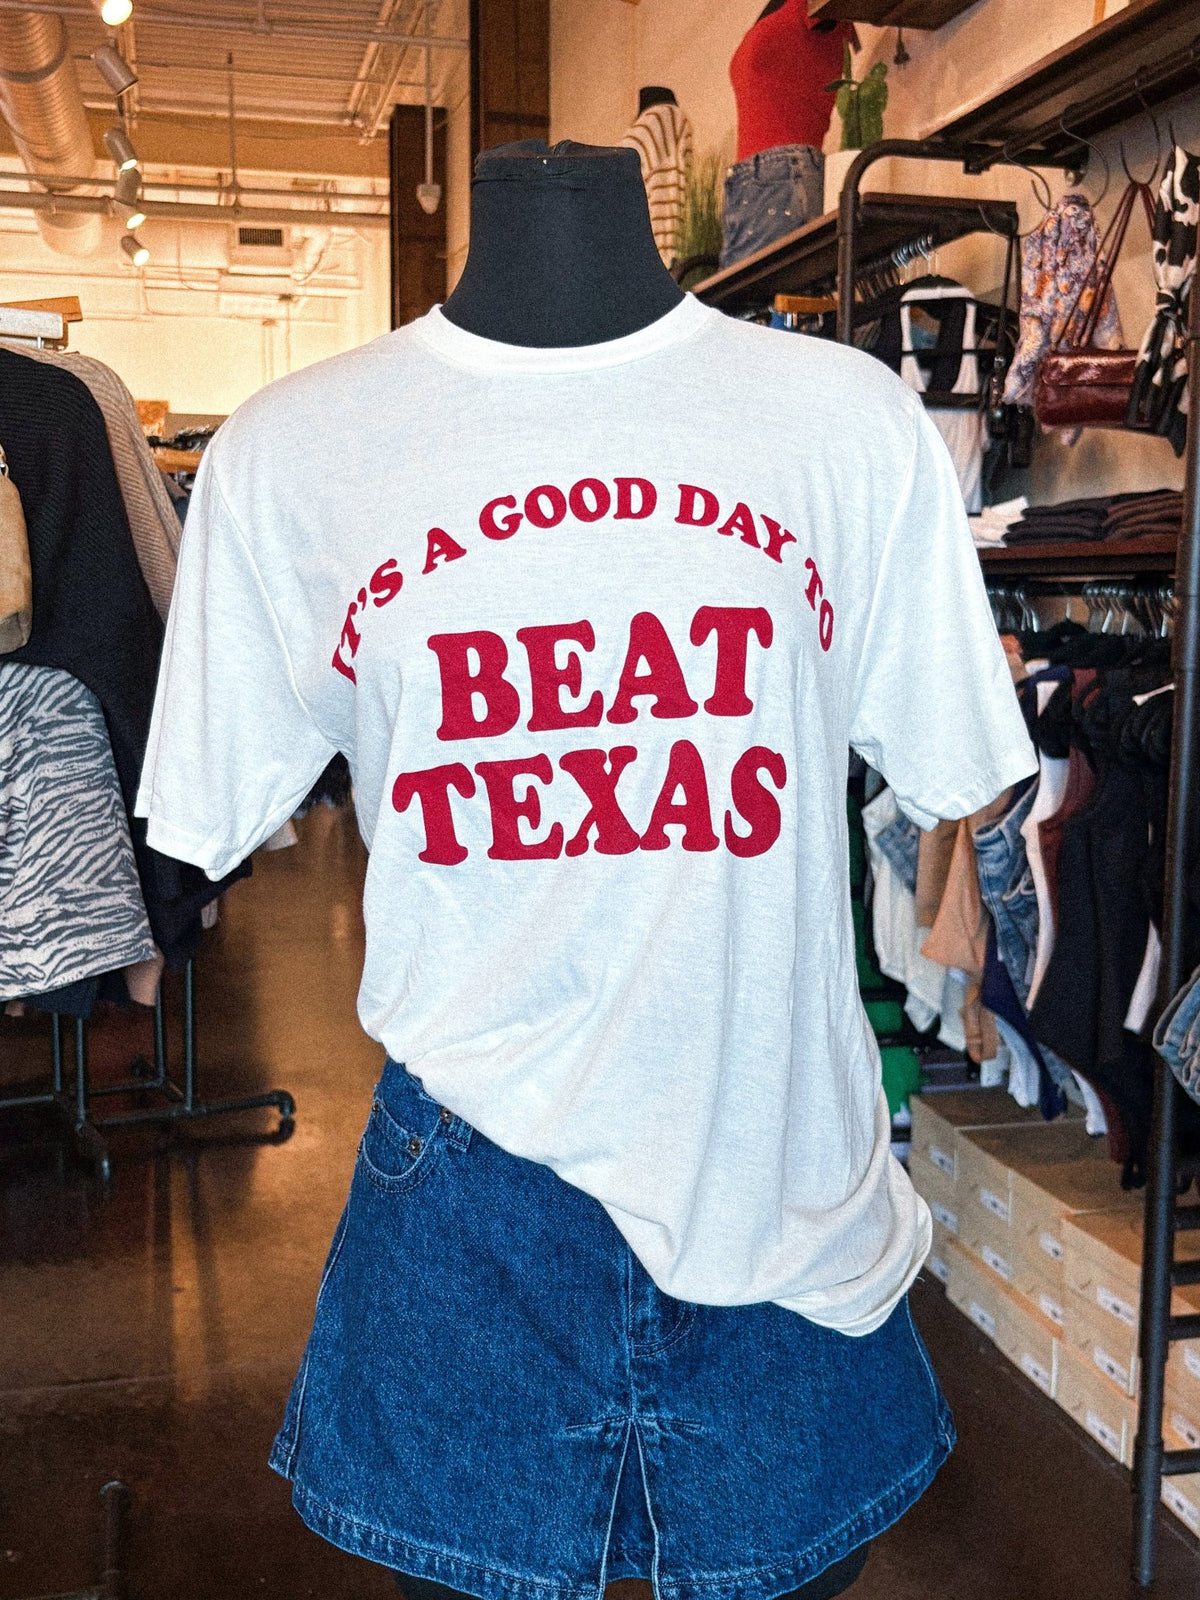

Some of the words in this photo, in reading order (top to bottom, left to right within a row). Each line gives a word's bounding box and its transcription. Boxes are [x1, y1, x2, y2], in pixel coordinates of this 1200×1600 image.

[422, 527, 467, 575] A
[478, 477, 658, 541] GOOD
[674, 483, 797, 564] DAY
[804, 557, 834, 652] TO
[426, 605, 774, 742] BEAT
[391, 739, 787, 866] TEXAS
